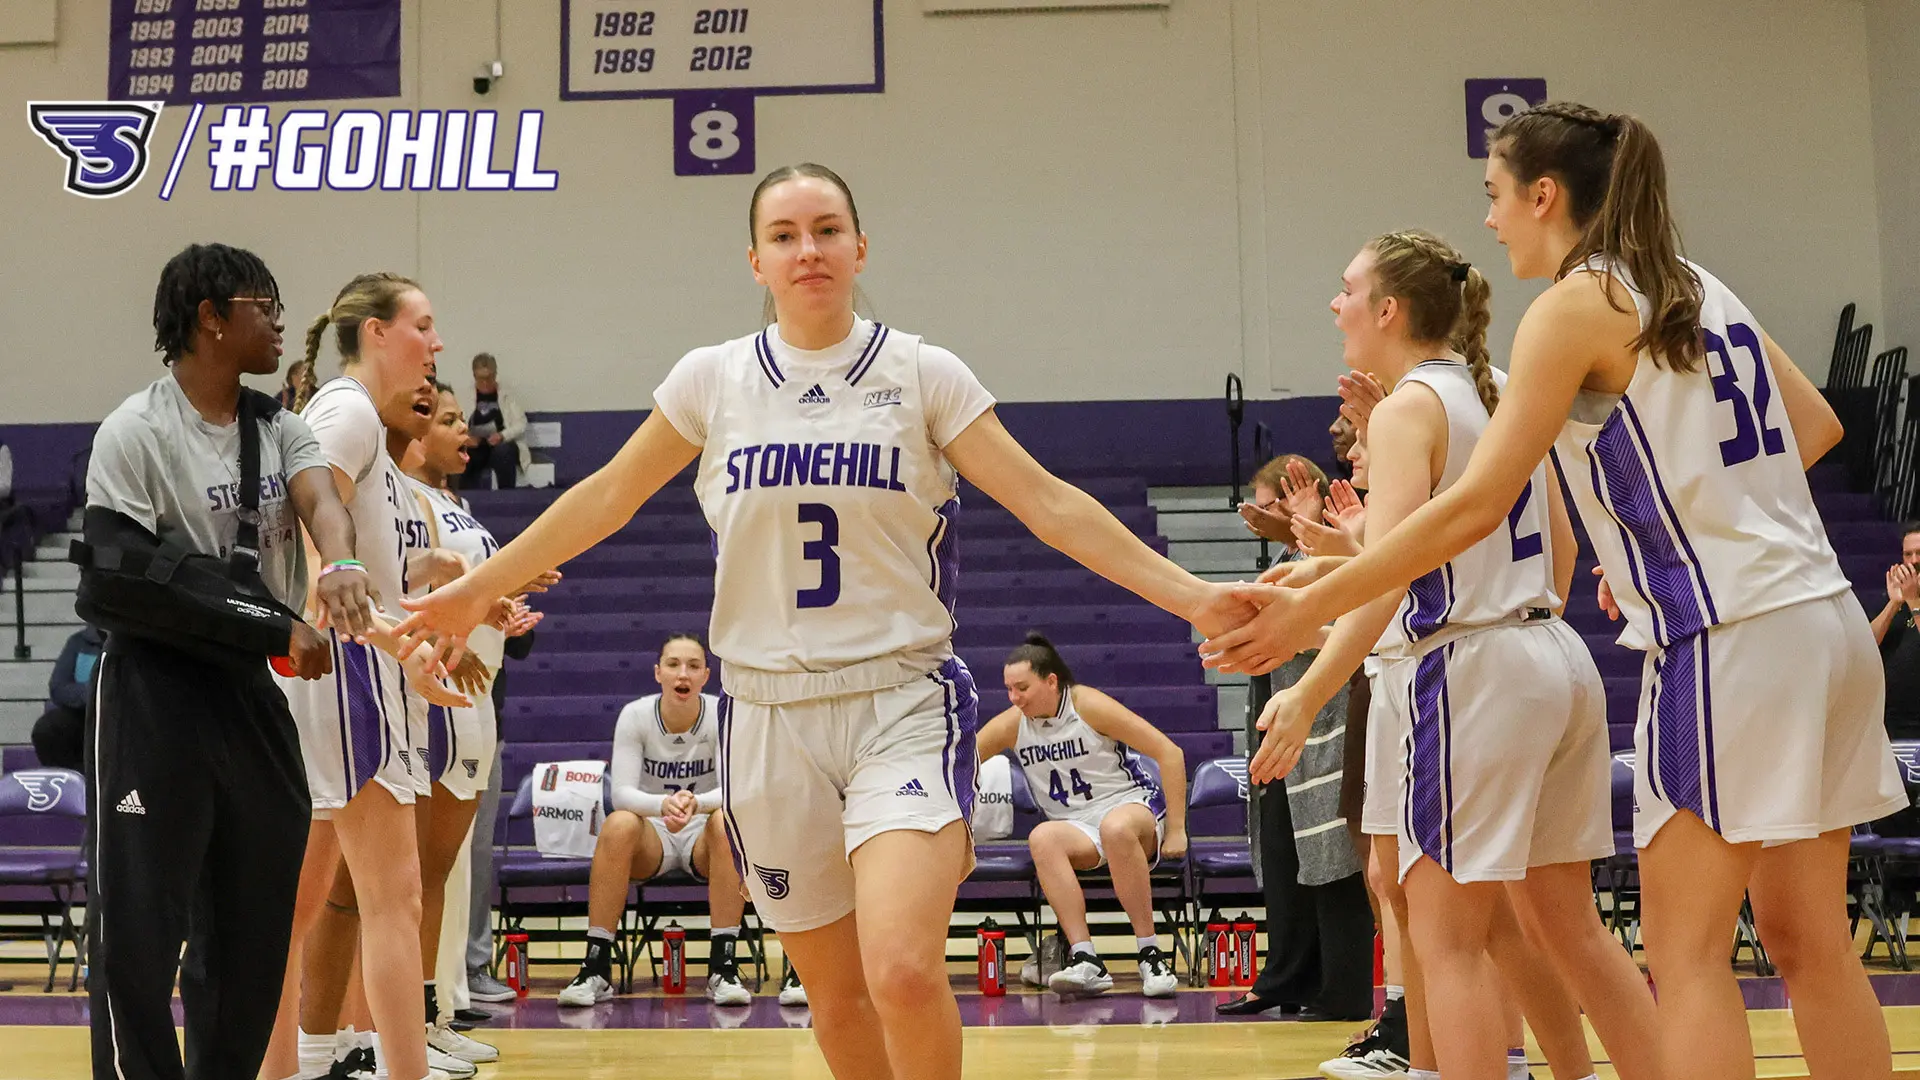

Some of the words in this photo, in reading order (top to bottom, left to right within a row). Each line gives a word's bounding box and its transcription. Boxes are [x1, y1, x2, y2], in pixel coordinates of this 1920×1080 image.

[130, 20, 175, 41] 1992
[192, 17, 244, 39] 2003
[263, 14, 309, 36] 2014
[594, 11, 655, 37] 1982
[694, 8, 748, 34] 2011
[130, 47, 174, 68] 1993
[191, 44, 243, 66] 2004
[262, 41, 309, 63] 2015
[594, 48, 655, 74] 1989
[690, 45, 752, 71] 2012
[129, 74, 174, 96] 1994
[190, 71, 243, 93] 2006
[262, 69, 309, 90] 2018
[688, 110, 740, 160] 8
[798, 395, 830, 404] adidas
[863, 387, 902, 411] NEC
[1703, 322, 1786, 467] 32
[725, 442, 906, 495] STONEHILL
[796, 503, 841, 609] 3
[1019, 737, 1089, 767] STONEHILL
[643, 757, 715, 779] STONEHILL
[895, 789, 929, 798] adidas
[1049, 768, 1094, 807] 44
[116, 804, 146, 815] adidas
